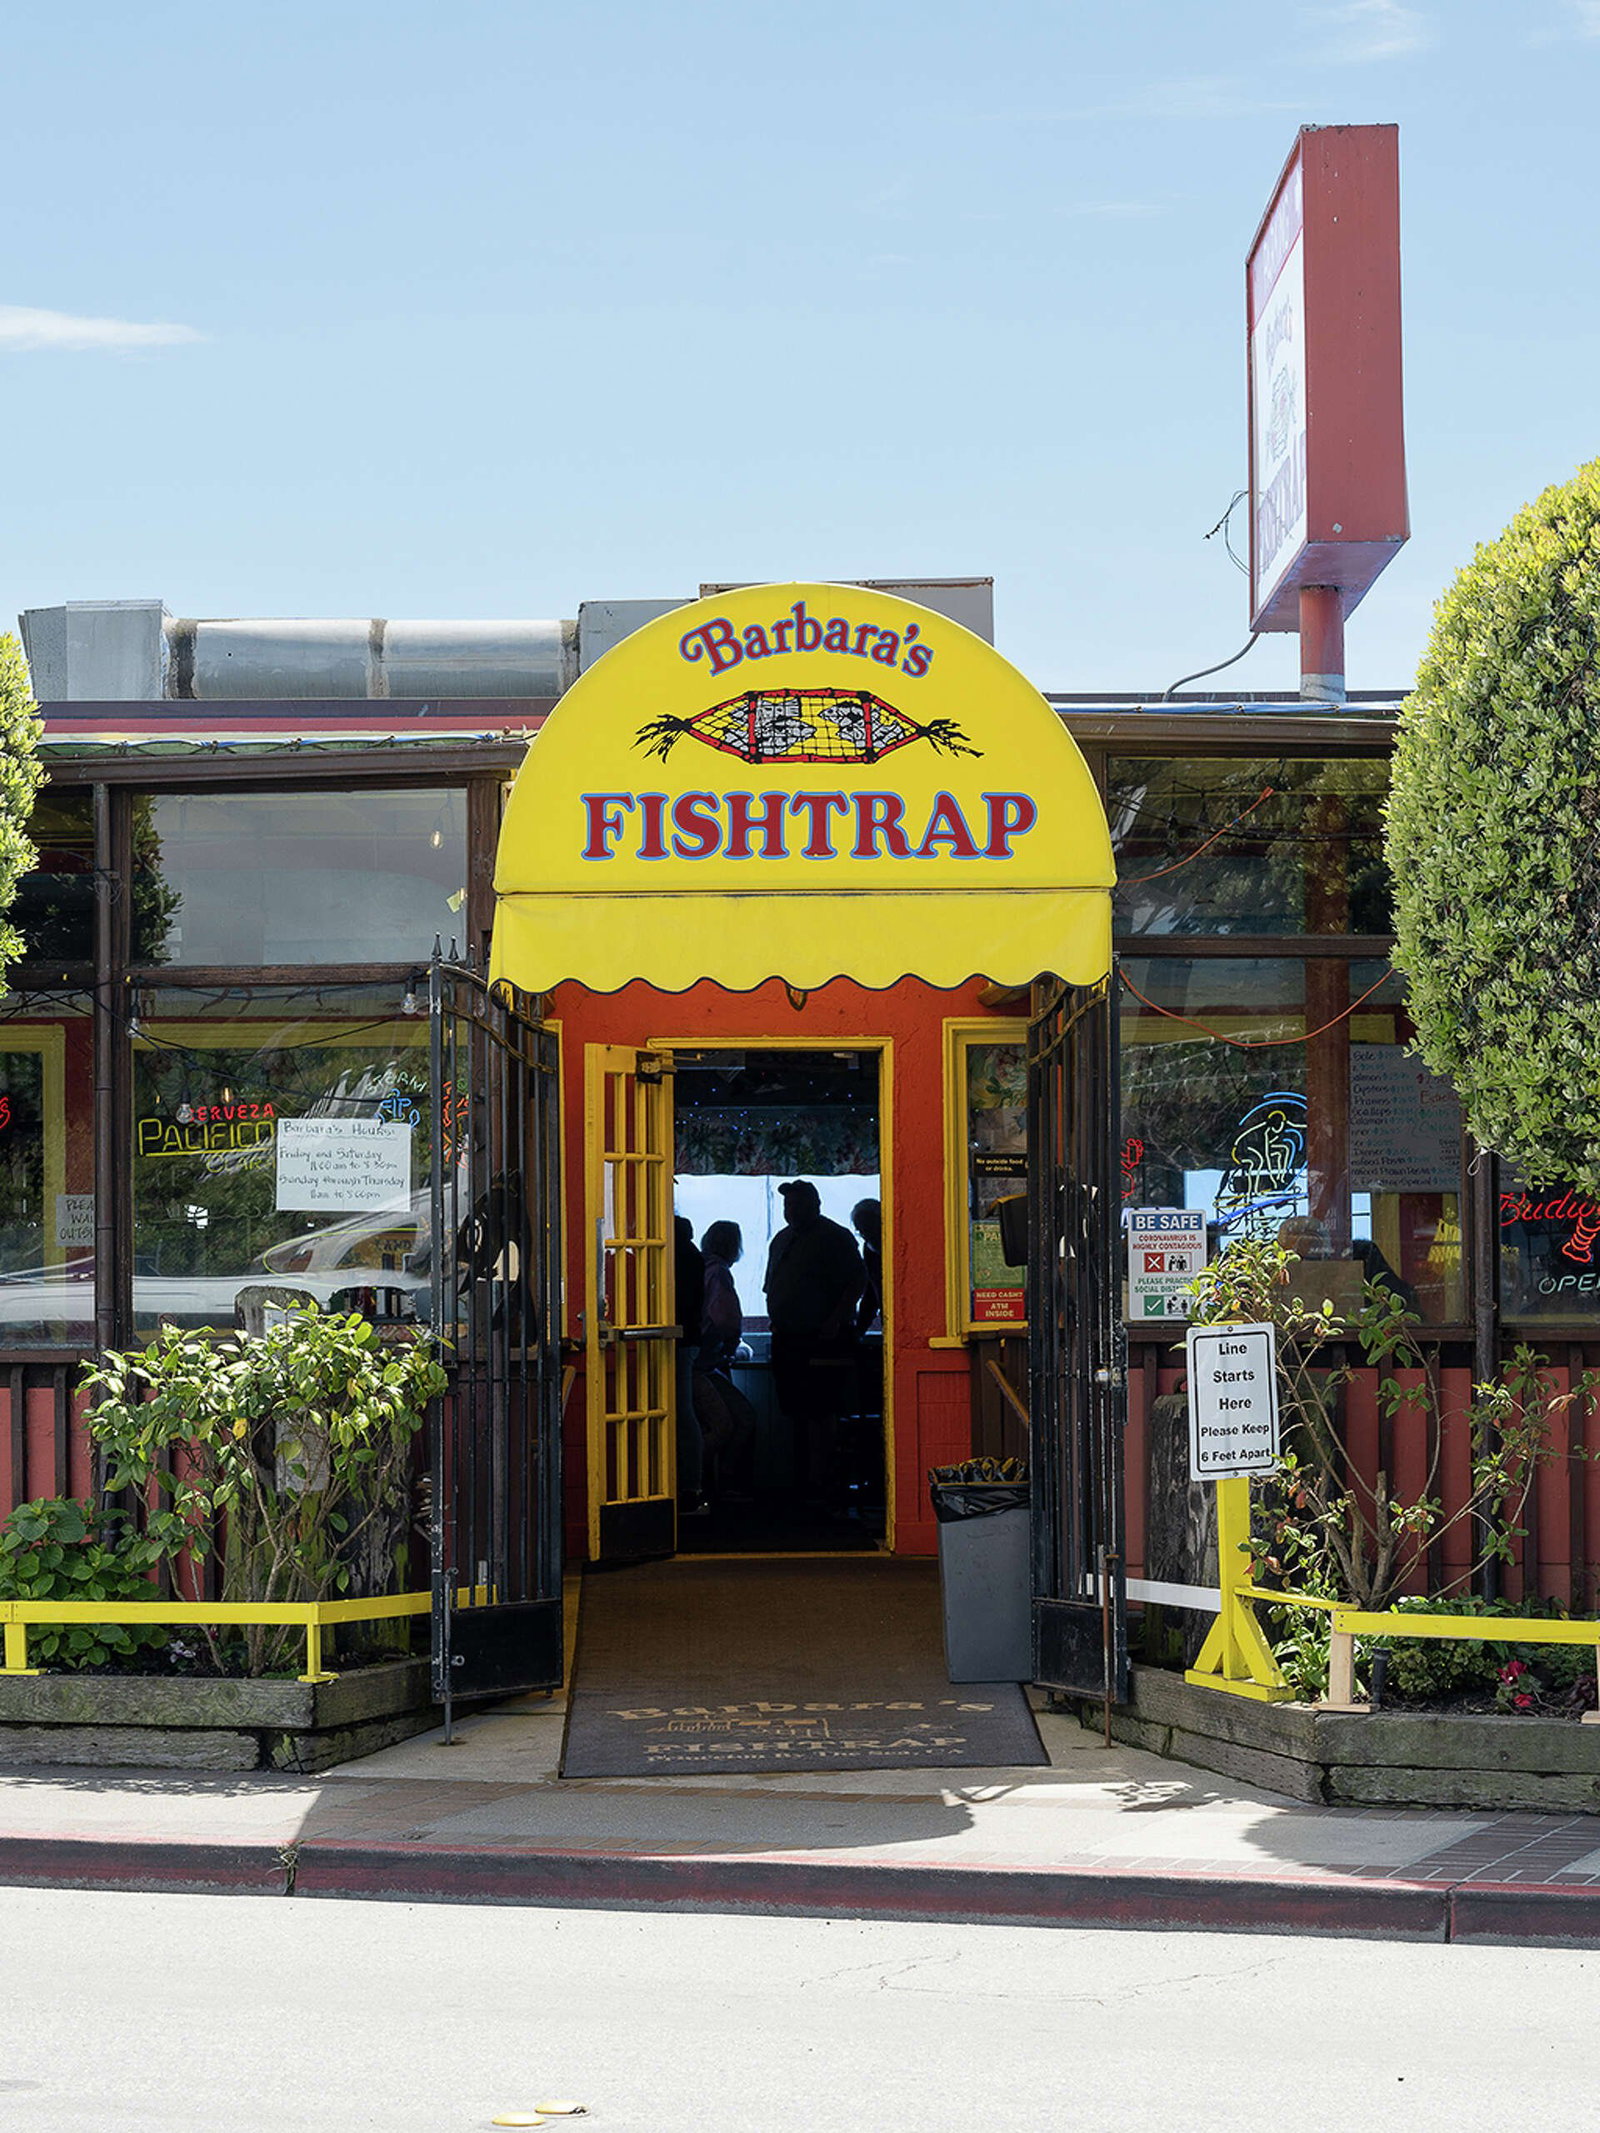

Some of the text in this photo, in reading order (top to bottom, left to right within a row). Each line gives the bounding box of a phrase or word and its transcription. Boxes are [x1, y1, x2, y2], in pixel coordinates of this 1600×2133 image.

[679, 601, 934, 679] Barbara's
[580, 790, 1038, 861] FISHTRAP
[283, 1121, 343, 1134] Barbara's
[316, 1150, 332, 1159] and
[337, 1147, 383, 1160] Saturday
[279, 1174, 319, 1187] Sunday
[361, 1175, 405, 1188] Thursday
[66, 1199, 94, 1211] PLEA
[71, 1213, 93, 1224] WAI
[1136, 1216, 1199, 1229] BE SAFE
[60, 1227, 93, 1239] OUTSI
[1139, 1234, 1187, 1242] CORONAVIRUS
[1133, 1242, 1202, 1250] HIGHLY CONTAGIOUS
[1134, 1285, 1158, 1293] SOCIAL
[1539, 1273, 1600, 1294] OPE
[1219, 1342, 1247, 1355] Line
[1213, 1370, 1254, 1383] Starts
[1219, 1398, 1252, 1410] Here
[1201, 1423, 1269, 1437] Please Keep
[1201, 1447, 1270, 1462] 6 Feet Apart
[606, 1699, 994, 1720] Barbara's
[642, 1736, 967, 1752] FISHTRAP
